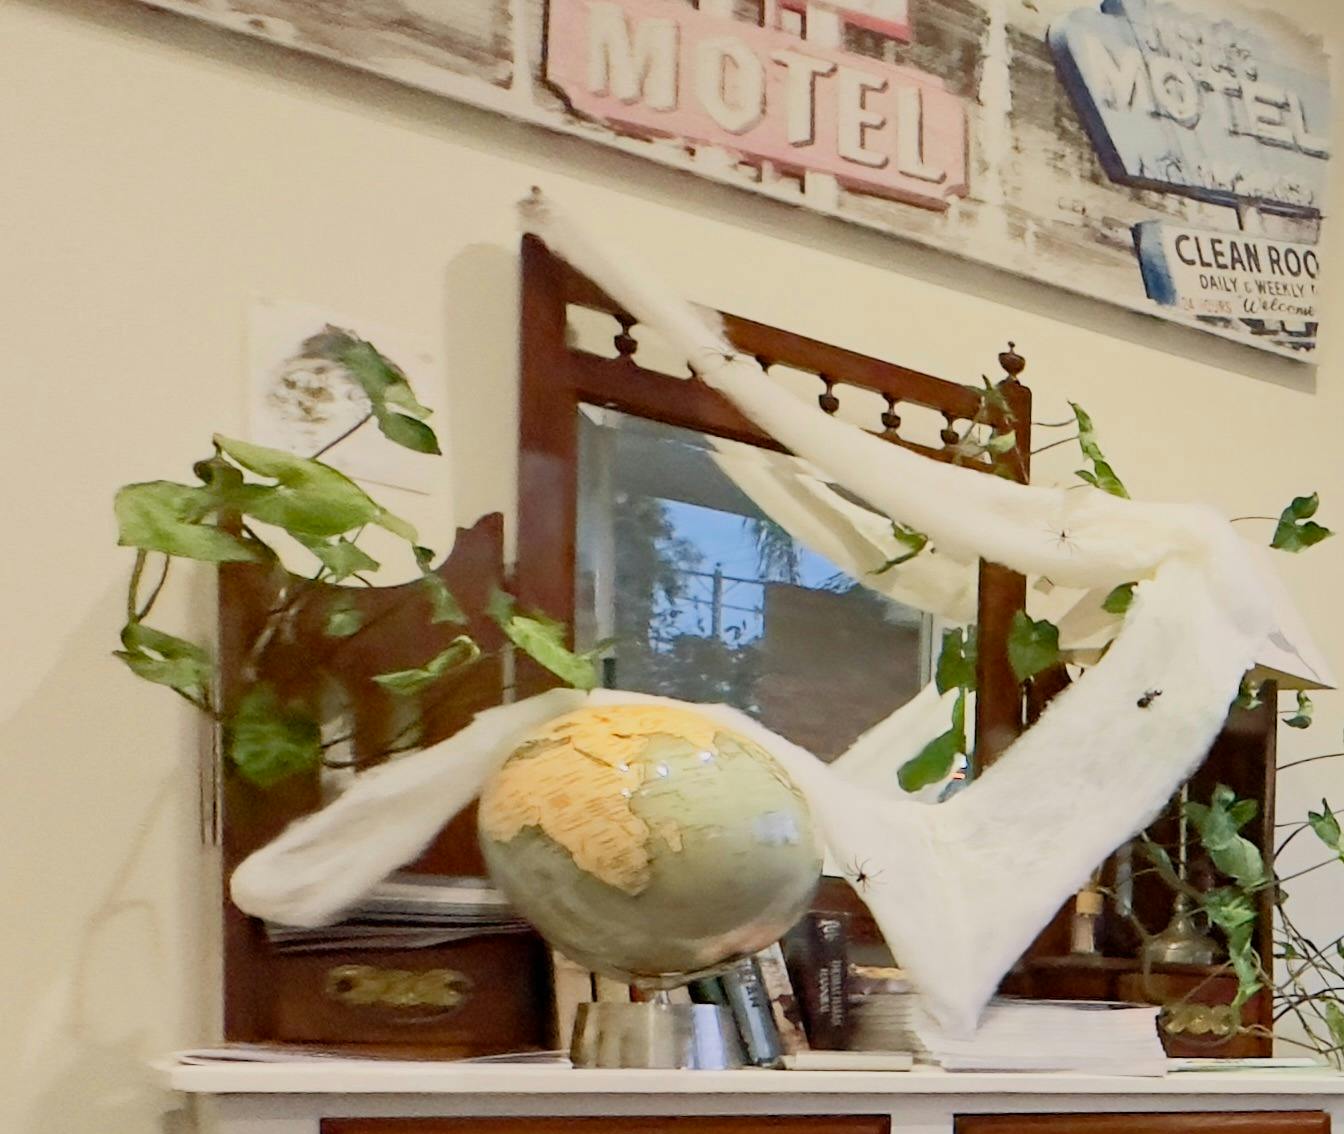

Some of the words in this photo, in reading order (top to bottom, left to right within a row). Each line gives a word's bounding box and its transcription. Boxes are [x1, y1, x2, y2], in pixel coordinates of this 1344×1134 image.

[587, 3, 947, 184] MOTEL
[1080, 34, 1330, 160] MOTEL
[1175, 234, 1262, 274] CLEAN
[1200, 273, 1238, 292] DAILY
[1255, 279, 1304, 298] WEEKLY
